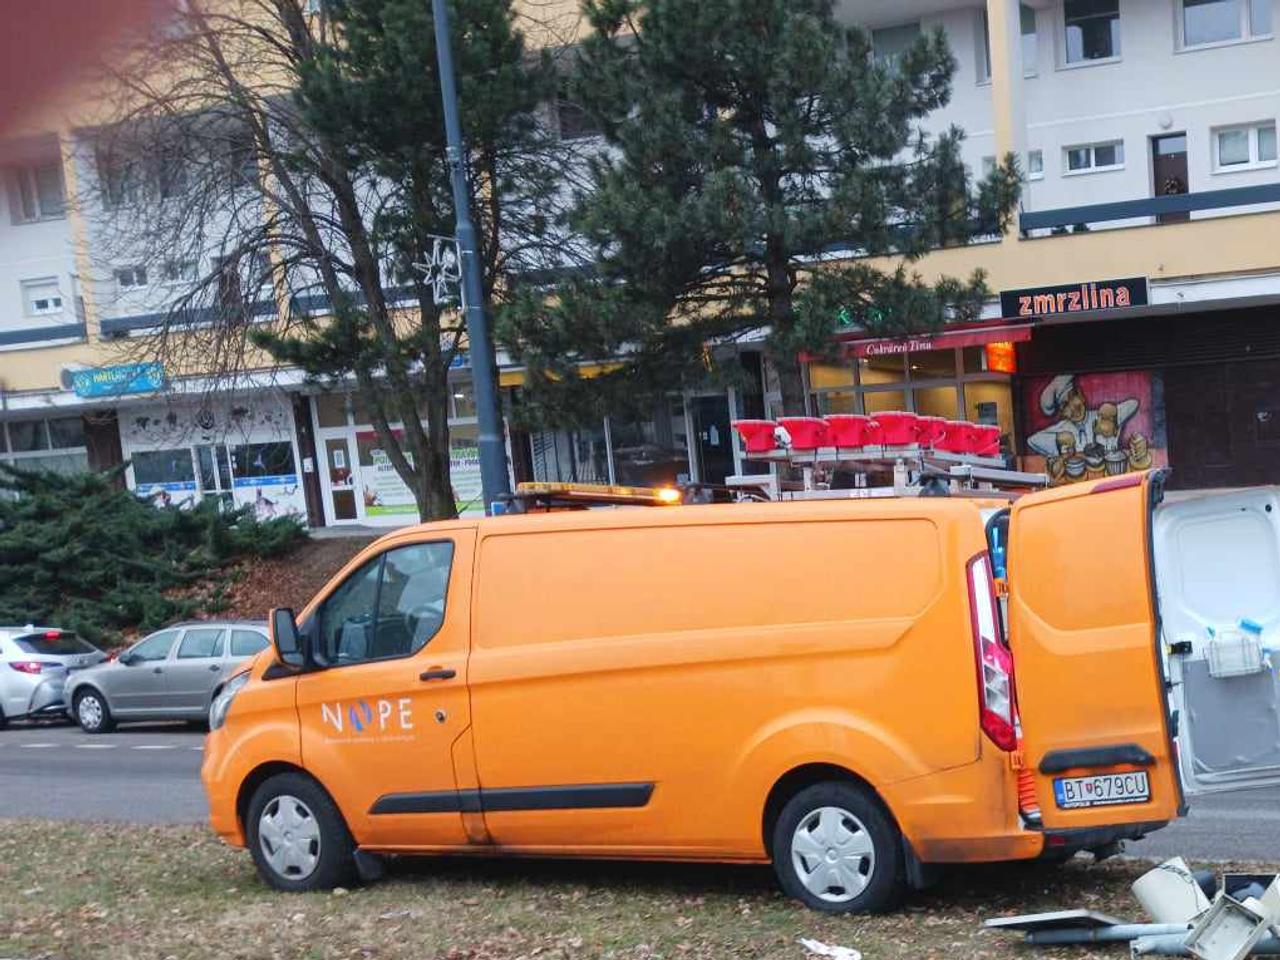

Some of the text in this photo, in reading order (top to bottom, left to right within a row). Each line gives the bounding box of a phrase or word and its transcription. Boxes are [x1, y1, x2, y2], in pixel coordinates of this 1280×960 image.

[1019, 283, 1131, 316] zmrzlina
[1064, 774, 1146, 800] BT 679CU
